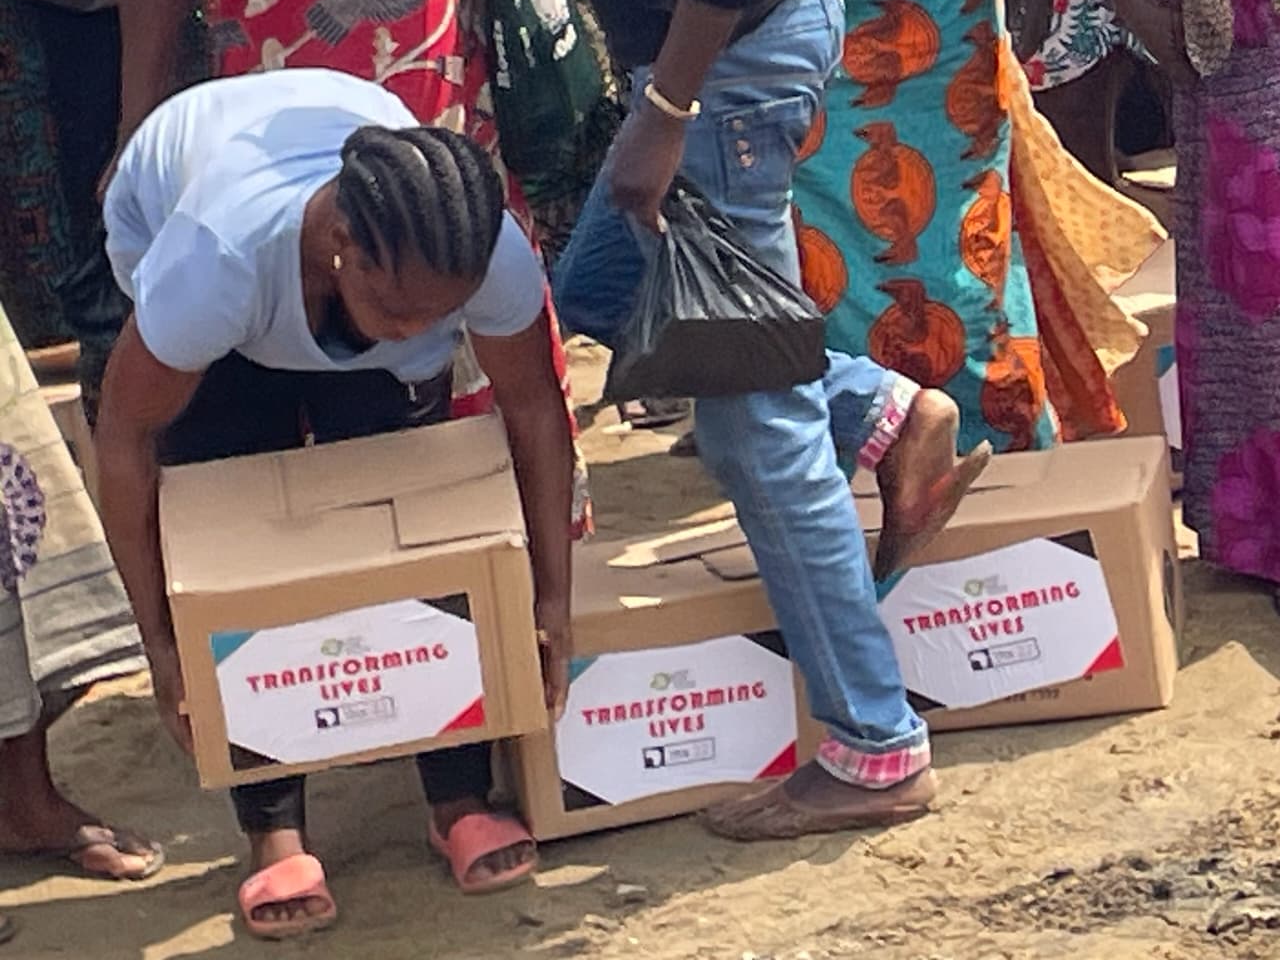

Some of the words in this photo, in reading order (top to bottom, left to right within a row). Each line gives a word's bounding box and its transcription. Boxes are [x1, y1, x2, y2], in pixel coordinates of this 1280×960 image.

[903, 582, 1081, 635] TRANSFORMING
[969, 616, 1025, 642] LIVES
[247, 644, 449, 693] TRANSFORMING
[320, 675, 382, 701] LIVES
[582, 682, 767, 725] TRANSFORMING
[650, 713, 705, 737] LIVES
